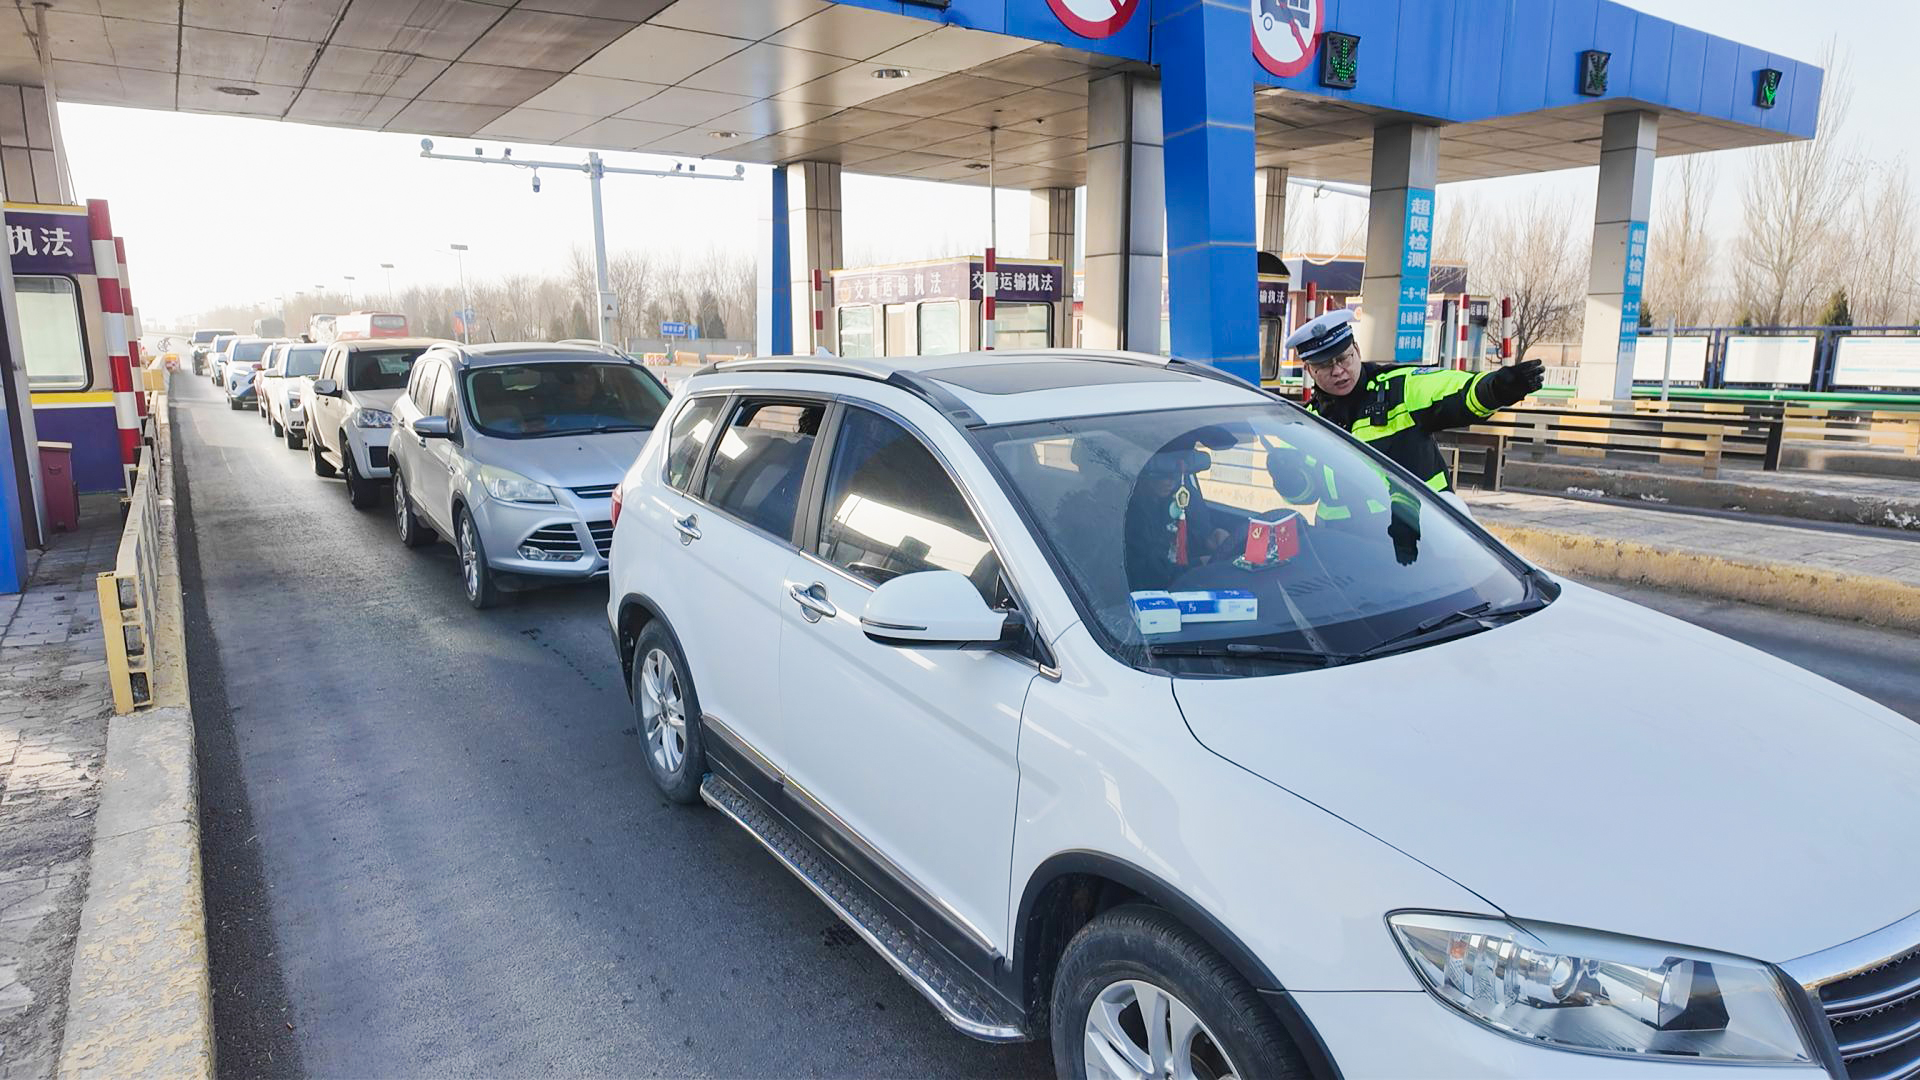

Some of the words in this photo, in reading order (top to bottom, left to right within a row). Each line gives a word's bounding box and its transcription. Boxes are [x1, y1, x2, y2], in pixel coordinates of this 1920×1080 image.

[6, 225, 73, 257] 执法
[1407, 198, 1430, 269] 超限检测
[1627, 229, 1645, 287] 超限检测
